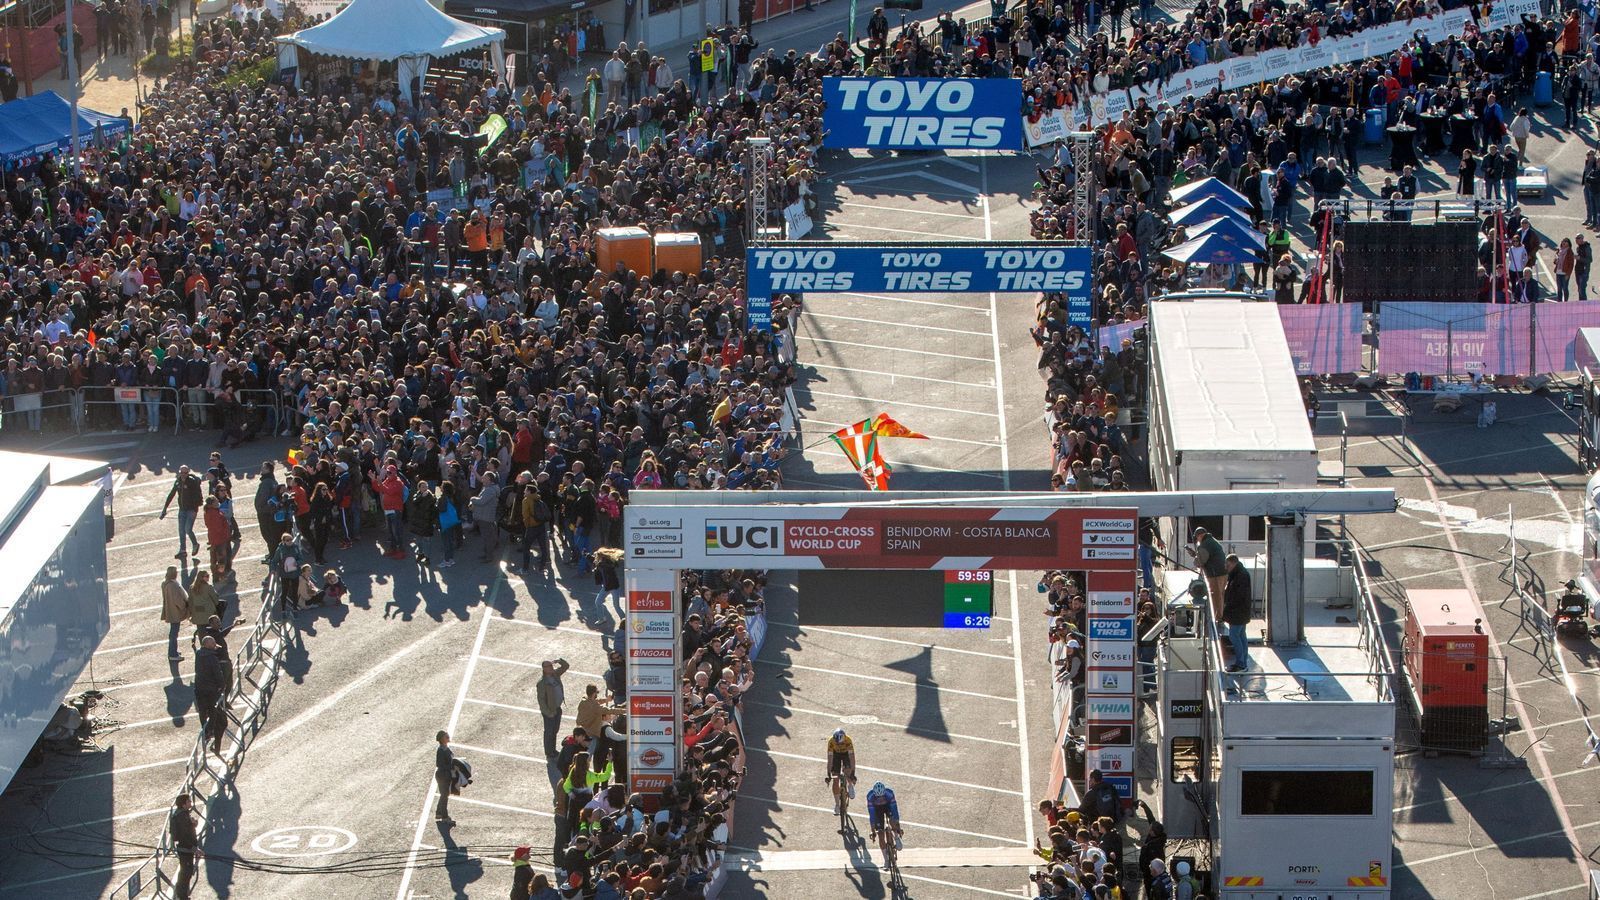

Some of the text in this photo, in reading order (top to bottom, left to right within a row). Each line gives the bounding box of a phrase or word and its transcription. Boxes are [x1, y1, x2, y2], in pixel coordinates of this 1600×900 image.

[474, 7, 498, 15] DECATHLON
[838, 80, 974, 112] TOYO
[863, 116, 1006, 147] TIRES
[754, 250, 836, 270] TOYO
[881, 252, 942, 268] TOYO
[983, 250, 1066, 270] TOYO
[769, 272, 855, 290] TIRES
[883, 271, 973, 290] TIRES
[997, 270, 1086, 290] TIRES
[649, 518, 671, 526] uci.org
[1085, 521, 1132, 529] #CXWorldCup
[789, 526, 875, 537] CYCLO-CROSS
[887, 526, 951, 537] BENIDORM
[962, 527, 1002, 537] COSTA
[1005, 527, 1051, 537] BLANCA
[643, 533, 677, 542] uci_cycling
[720, 526, 778, 549] UCI
[789, 539, 862, 549] WORLD CUP
[887, 539, 921, 550] SPAIN
[958, 571, 990, 581] 59:59
[636, 591, 665, 608] ethias
[964, 616, 990, 626] 6:26
[1092, 621, 1121, 629] TOYO
[1091, 703, 1130, 713] WHIM
[1101, 752, 1122, 760] simac
[636, 780, 666, 788] STIHL
[269, 835, 337, 848] 20
